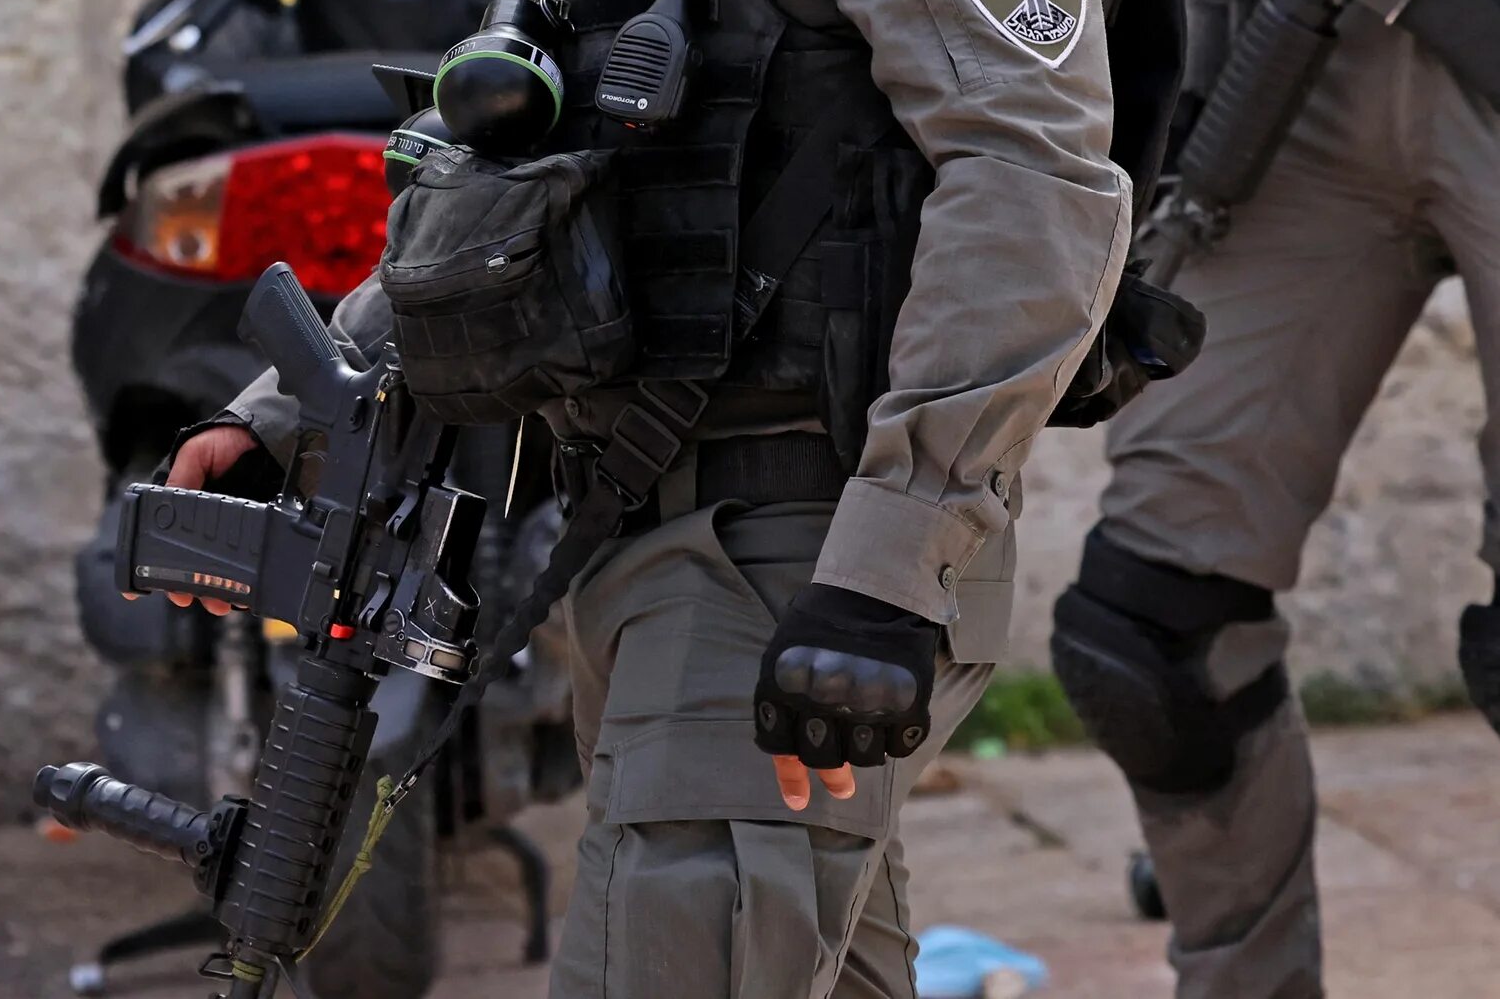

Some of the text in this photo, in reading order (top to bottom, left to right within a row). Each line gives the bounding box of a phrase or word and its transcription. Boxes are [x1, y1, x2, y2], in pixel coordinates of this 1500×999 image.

[1007, 9, 1073, 41] משמר הגבול
[601, 93, 636, 105] MOTOROLA
